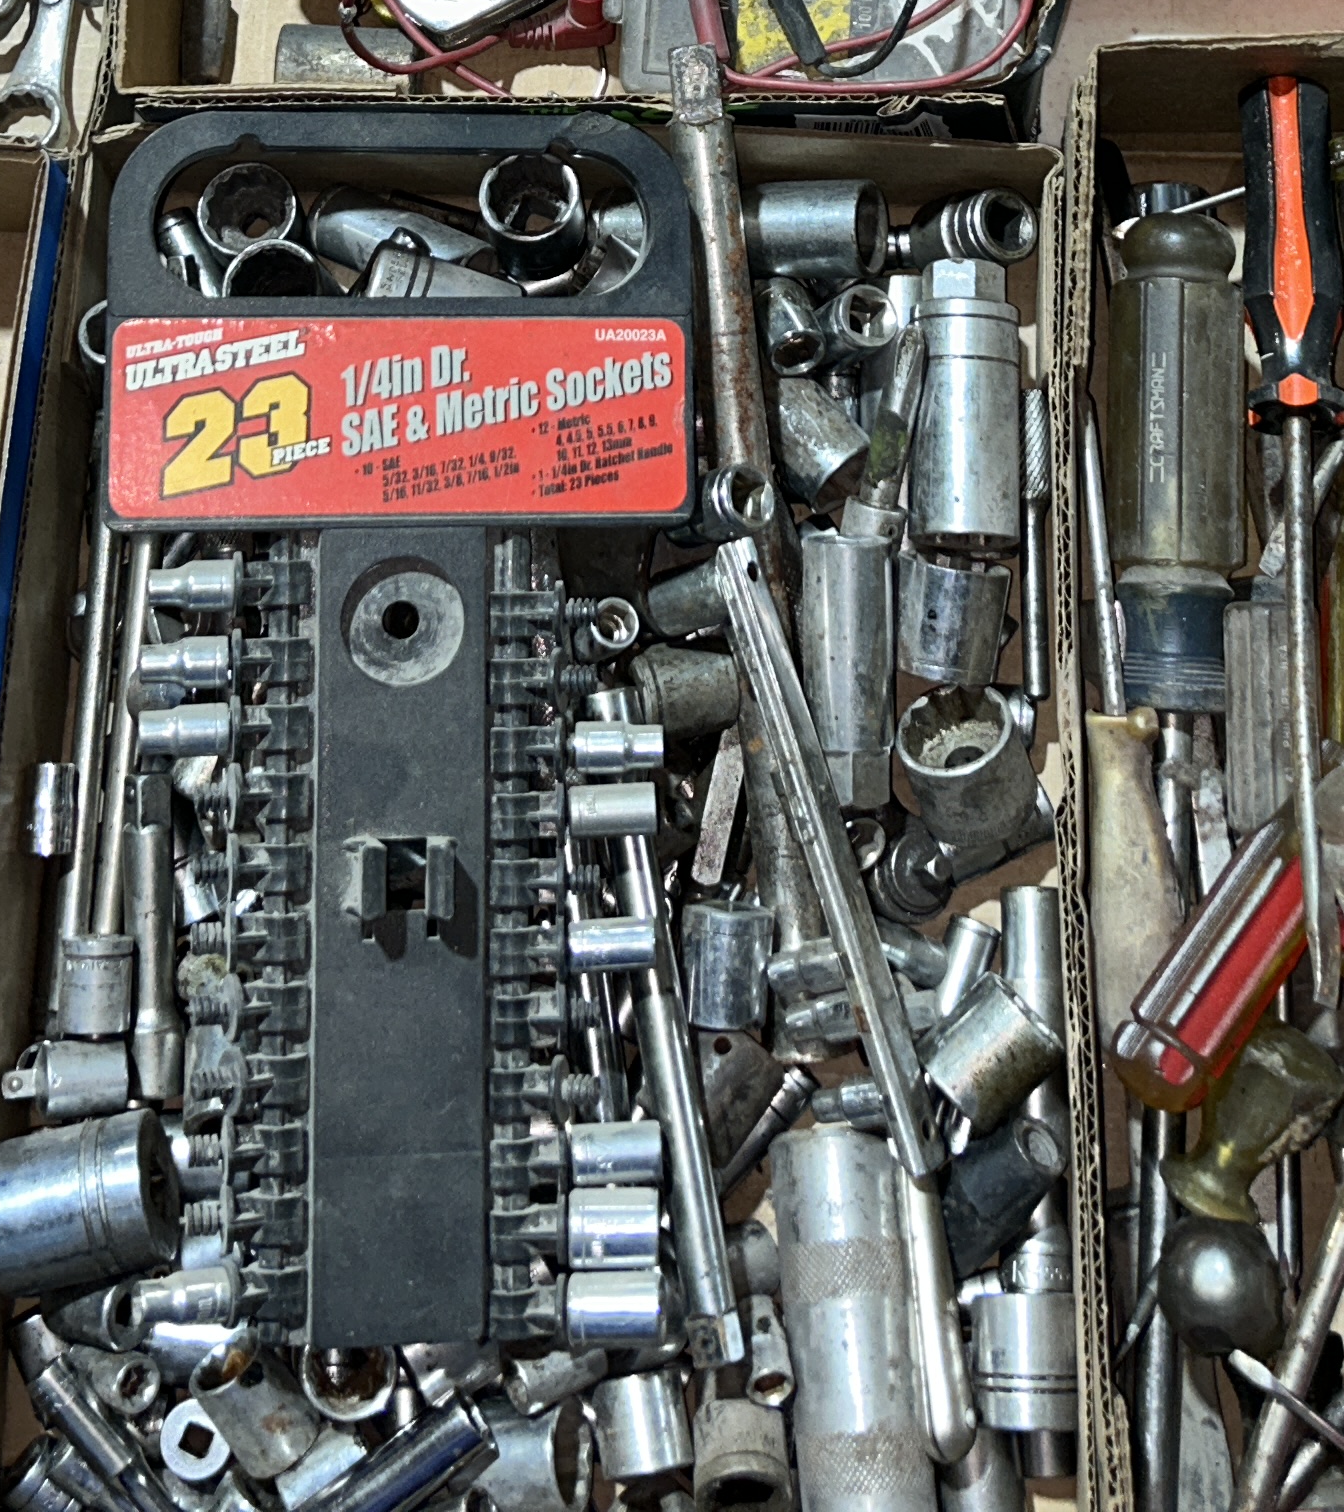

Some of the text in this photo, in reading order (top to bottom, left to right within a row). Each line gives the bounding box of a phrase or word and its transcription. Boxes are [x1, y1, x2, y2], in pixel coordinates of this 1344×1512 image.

[858, 6, 873, 29] 100
[125, 328, 224, 360] ULTRA-TOUGH
[595, 327, 667, 343] UA20023A
[125, 328, 306, 392] ULTRASTEEL
[340, 345, 472, 408] 1/4in Dr.
[340, 351, 673, 457] SAE & Metric Sockets
[1149, 367, 1165, 464] CRAFTSMAN
[160, 370, 312, 500] 23
[557, 413, 592, 431] Metric
[270, 436, 332, 468] PIECE
[382, 455, 402, 472] SAE
[552, 462, 579, 479] 1/4in
[595, 449, 636, 471] Ratchet
[637, 443, 674, 462] Handle
[569, 475, 584, 492] 23
[584, 470, 621, 488] Pieces
